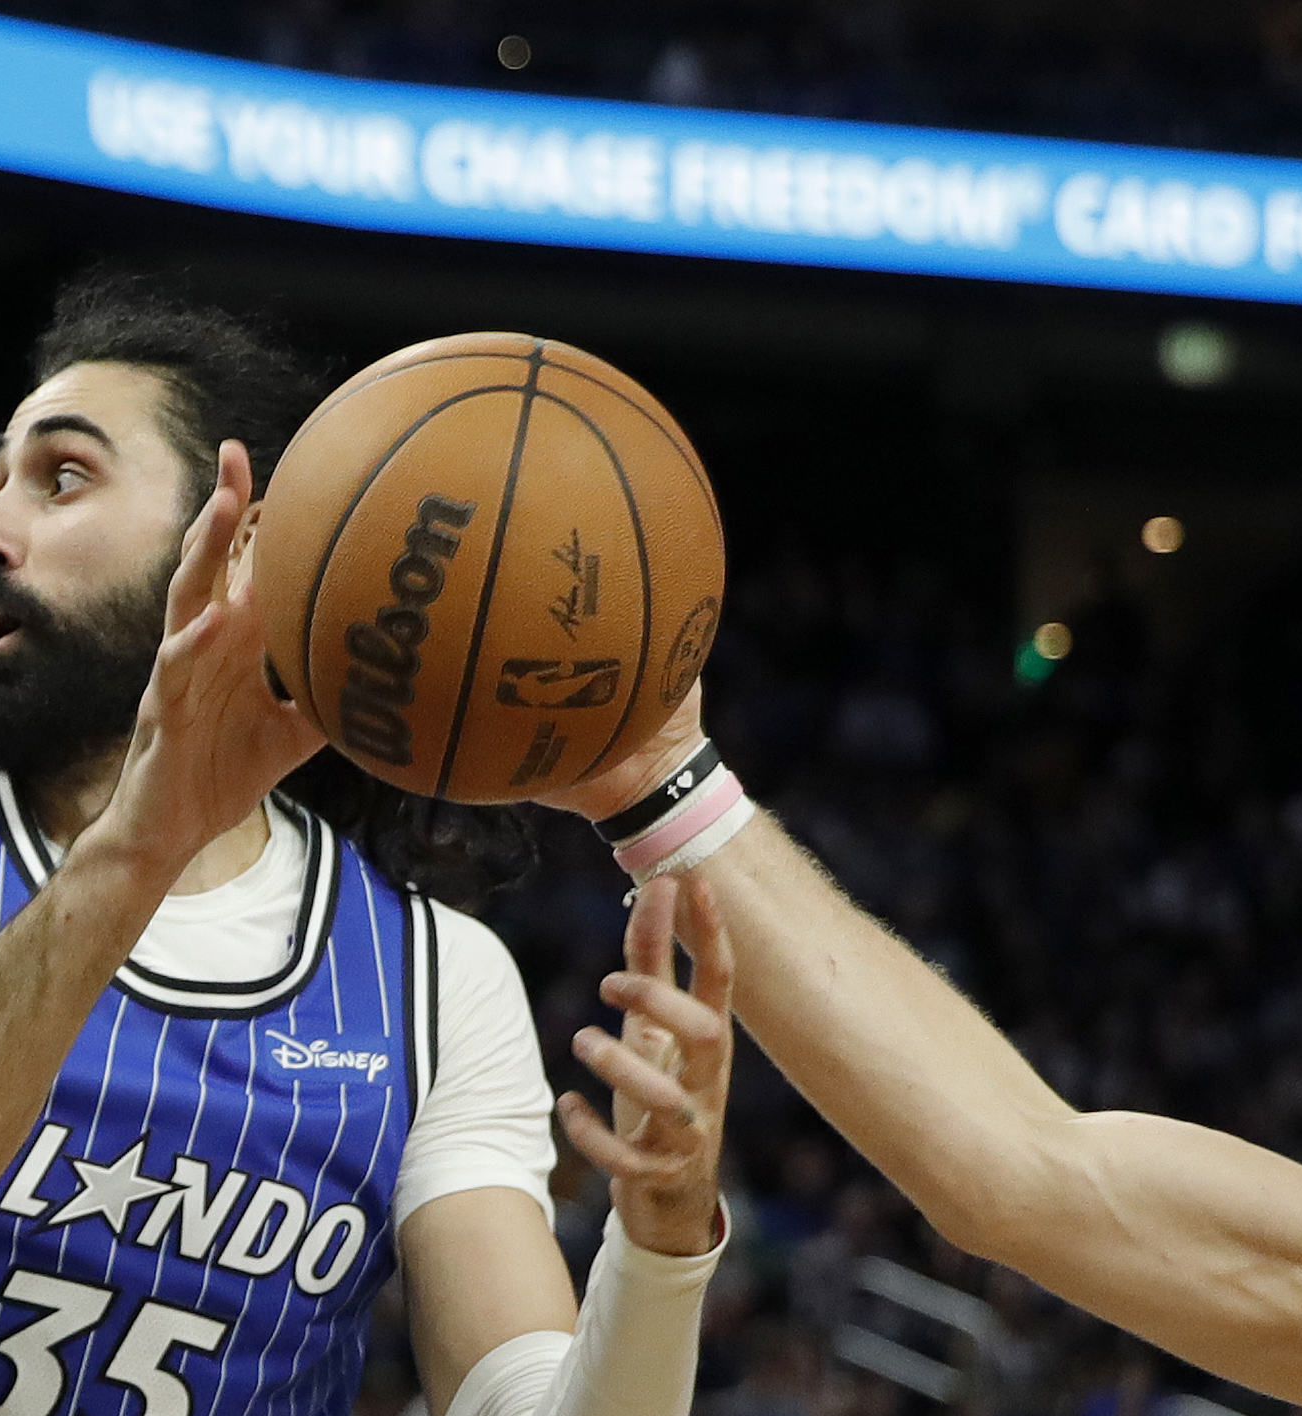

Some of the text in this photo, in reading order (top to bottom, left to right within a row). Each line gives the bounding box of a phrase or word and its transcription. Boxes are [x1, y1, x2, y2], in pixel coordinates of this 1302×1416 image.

[89, 72, 216, 174] USE
[220, 98, 417, 201] YOUR
[421, 120, 664, 222] CHASE
[1055, 170, 1259, 269] CARD
[265, 1028, 390, 1082] Disney
